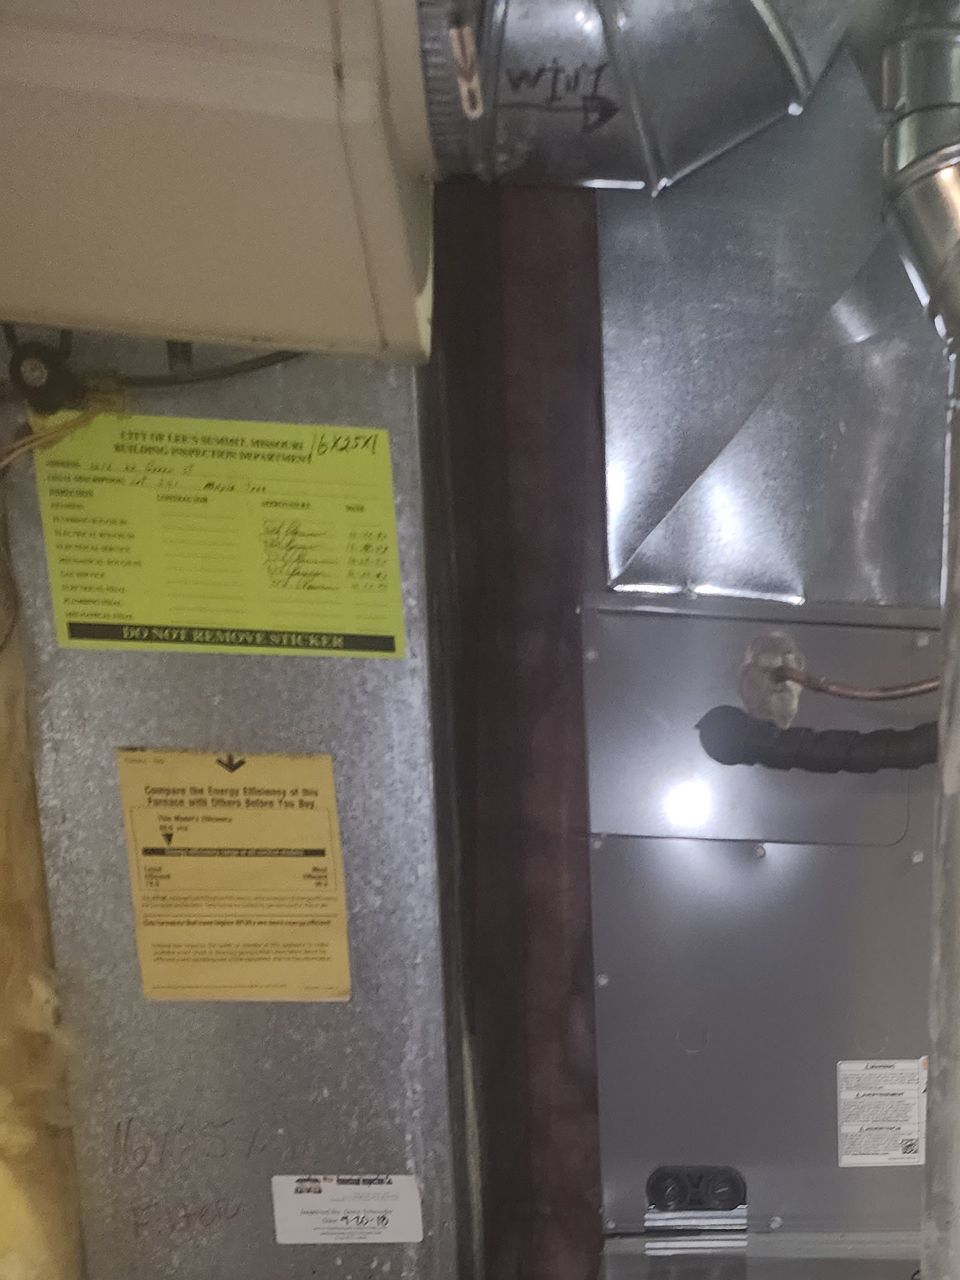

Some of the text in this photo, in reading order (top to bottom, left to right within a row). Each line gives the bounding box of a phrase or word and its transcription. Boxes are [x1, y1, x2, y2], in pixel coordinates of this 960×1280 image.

[122, 626, 345, 648] DO NOT REMOVE STICKER
[144, 786, 186, 797] Compare
[208, 786, 240, 798] Energy
